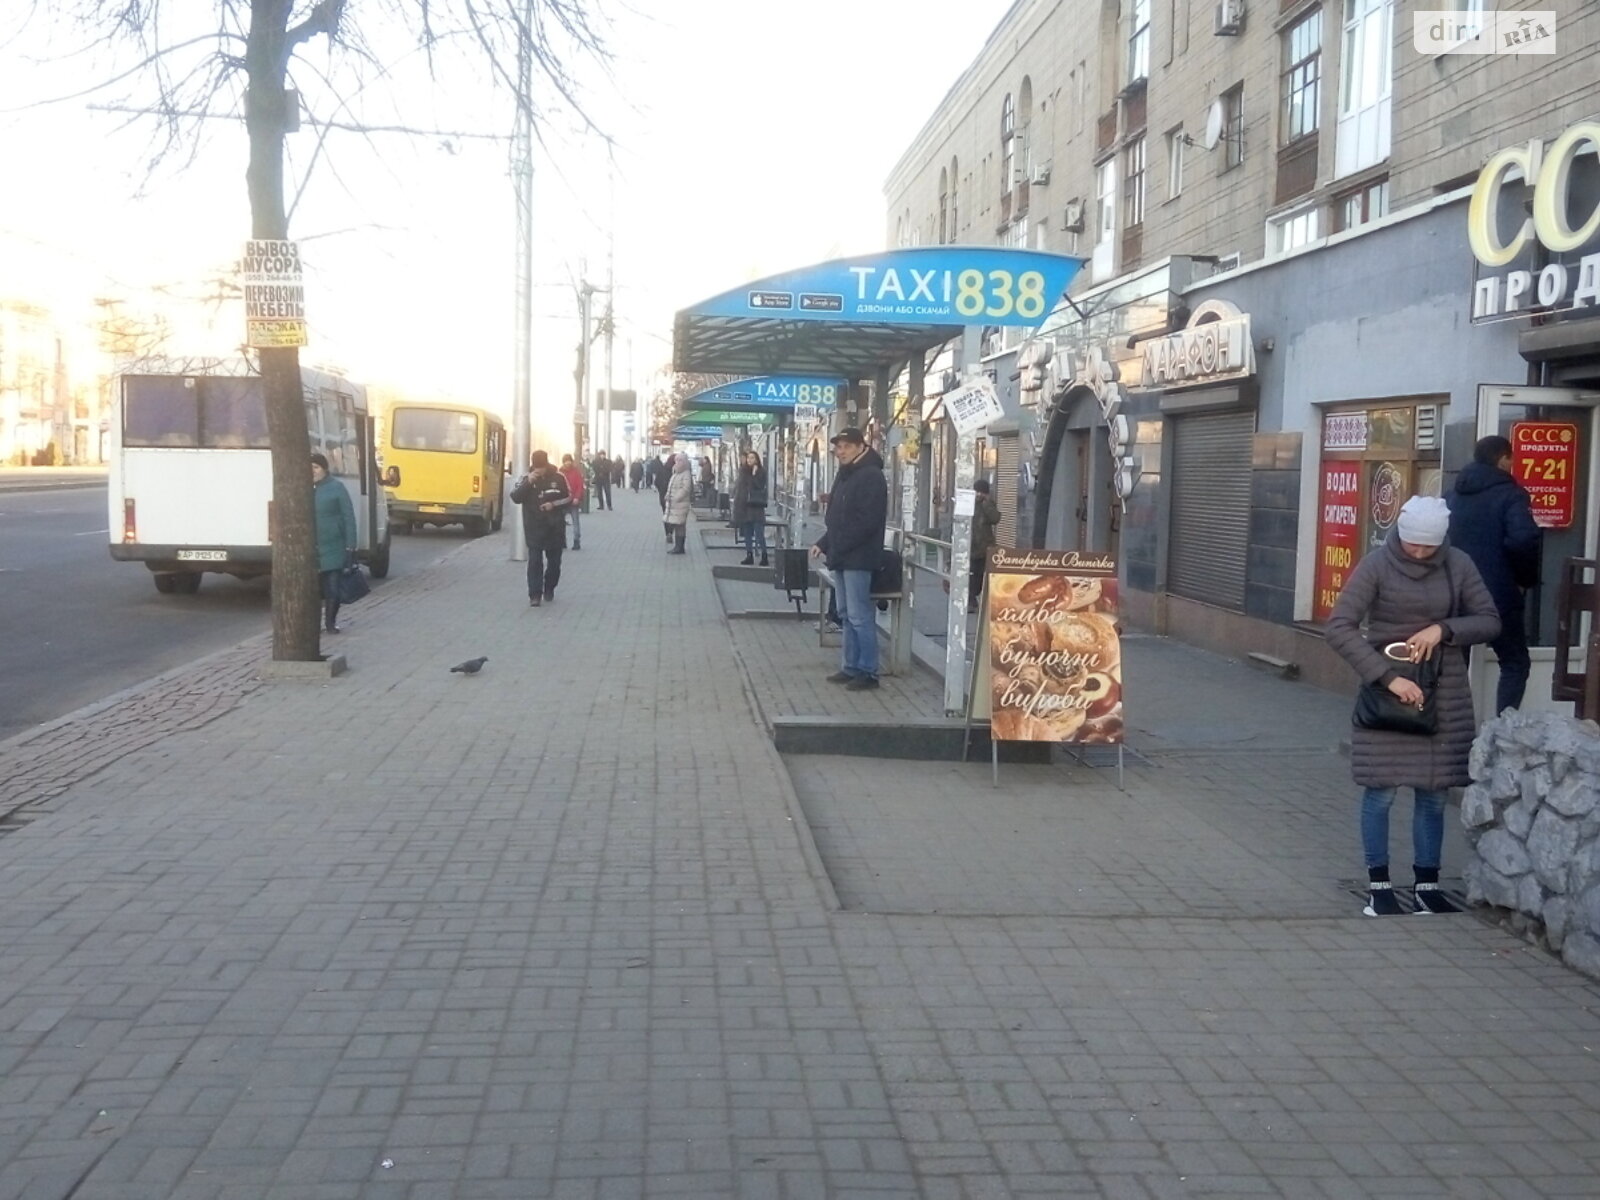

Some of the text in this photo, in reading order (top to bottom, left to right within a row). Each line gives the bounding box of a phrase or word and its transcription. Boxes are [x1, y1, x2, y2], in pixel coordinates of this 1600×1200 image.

[245, 241, 298, 257] ВЫВОЗ
[242, 257, 303, 274] МУСОРА
[244, 285, 305, 302] ПЕРЕВОЗИМ
[957, 268, 1046, 319] 838
[246, 302, 305, 317] МЕБЕЛЬ
[856, 304, 894, 313] ДЗВОНИ
[895, 305, 914, 314] АБО
[1142, 318, 1245, 389] МАРАФОН
[754, 382, 797, 398] TAXI
[798, 384, 835, 405] 838
[1522, 458, 1566, 480] 7-21
[1326, 472, 1358, 493] ВОДКА
[1324, 504, 1357, 525] СИГАРЕТЫ
[1325, 546, 1351, 568] ПИВО
[1331, 573, 1342, 587] на
